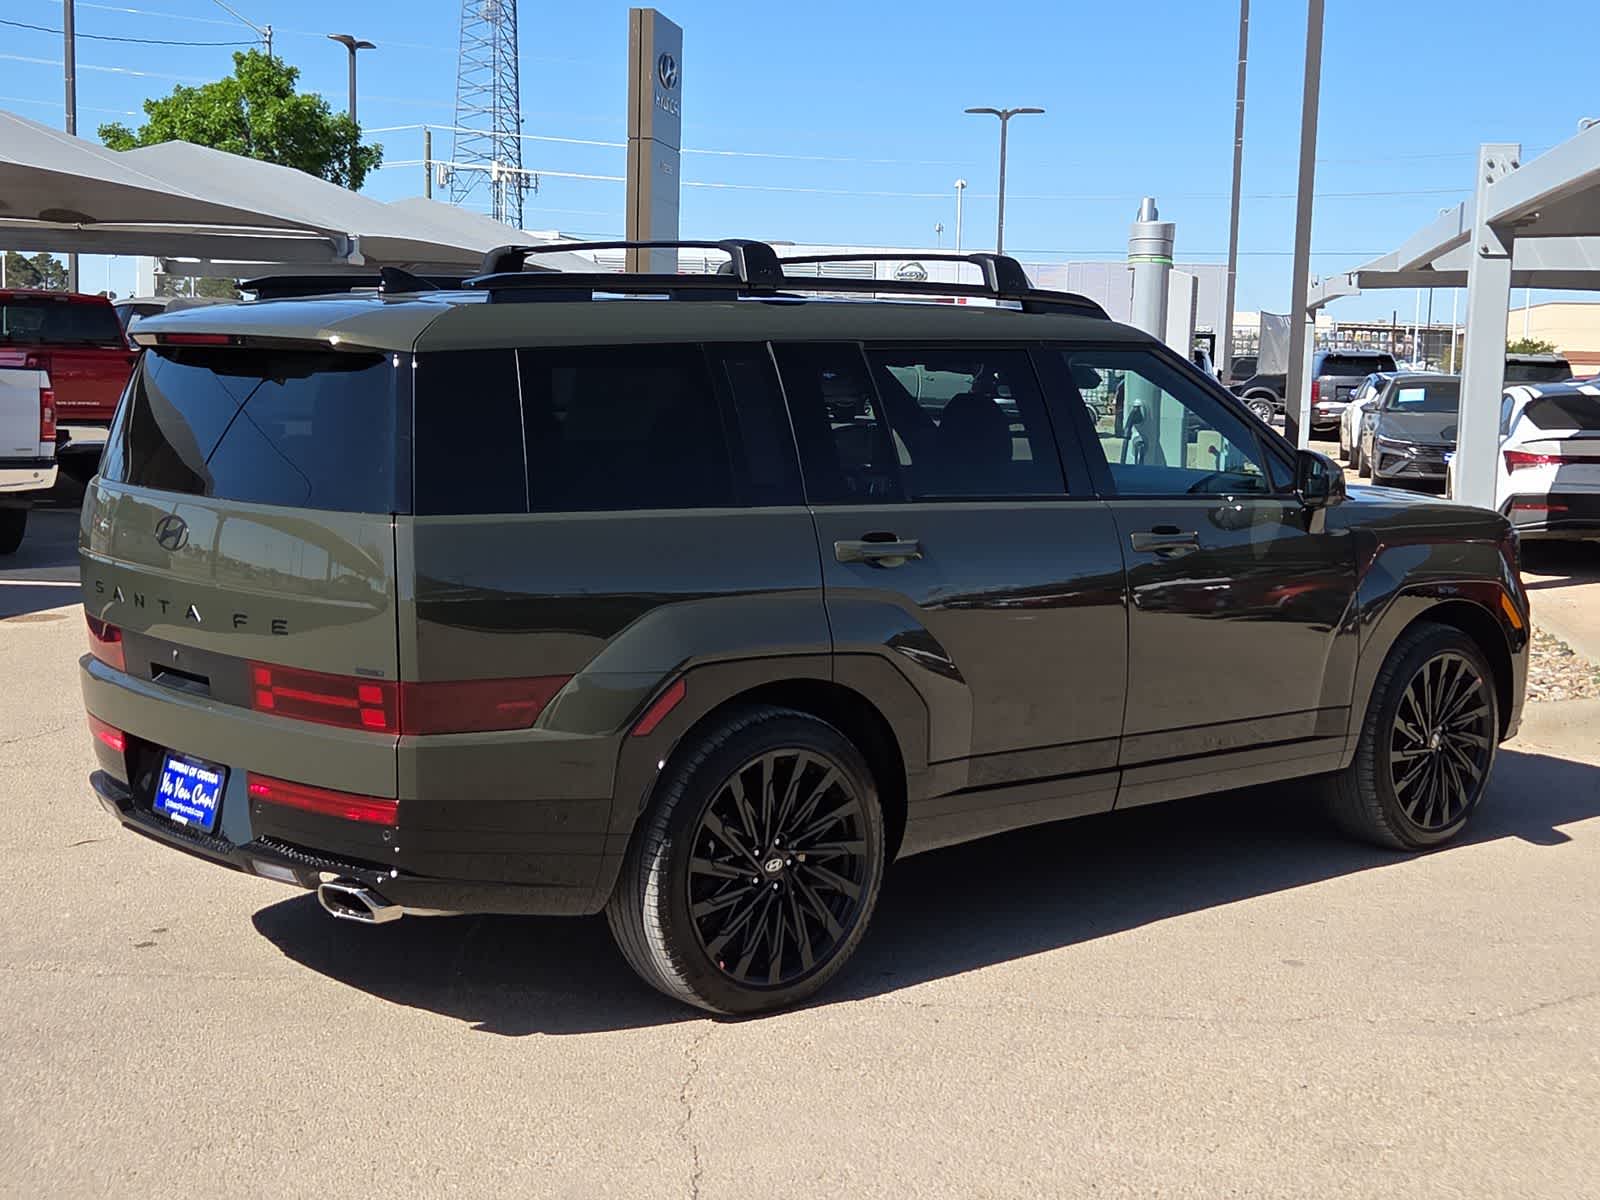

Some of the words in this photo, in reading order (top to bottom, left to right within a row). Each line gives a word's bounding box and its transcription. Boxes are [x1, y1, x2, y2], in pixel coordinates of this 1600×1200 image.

[96, 580, 201, 622] SANTA
[232, 613, 289, 635] FE
[174, 776, 191, 800] You
[191, 783, 219, 810] Can!
